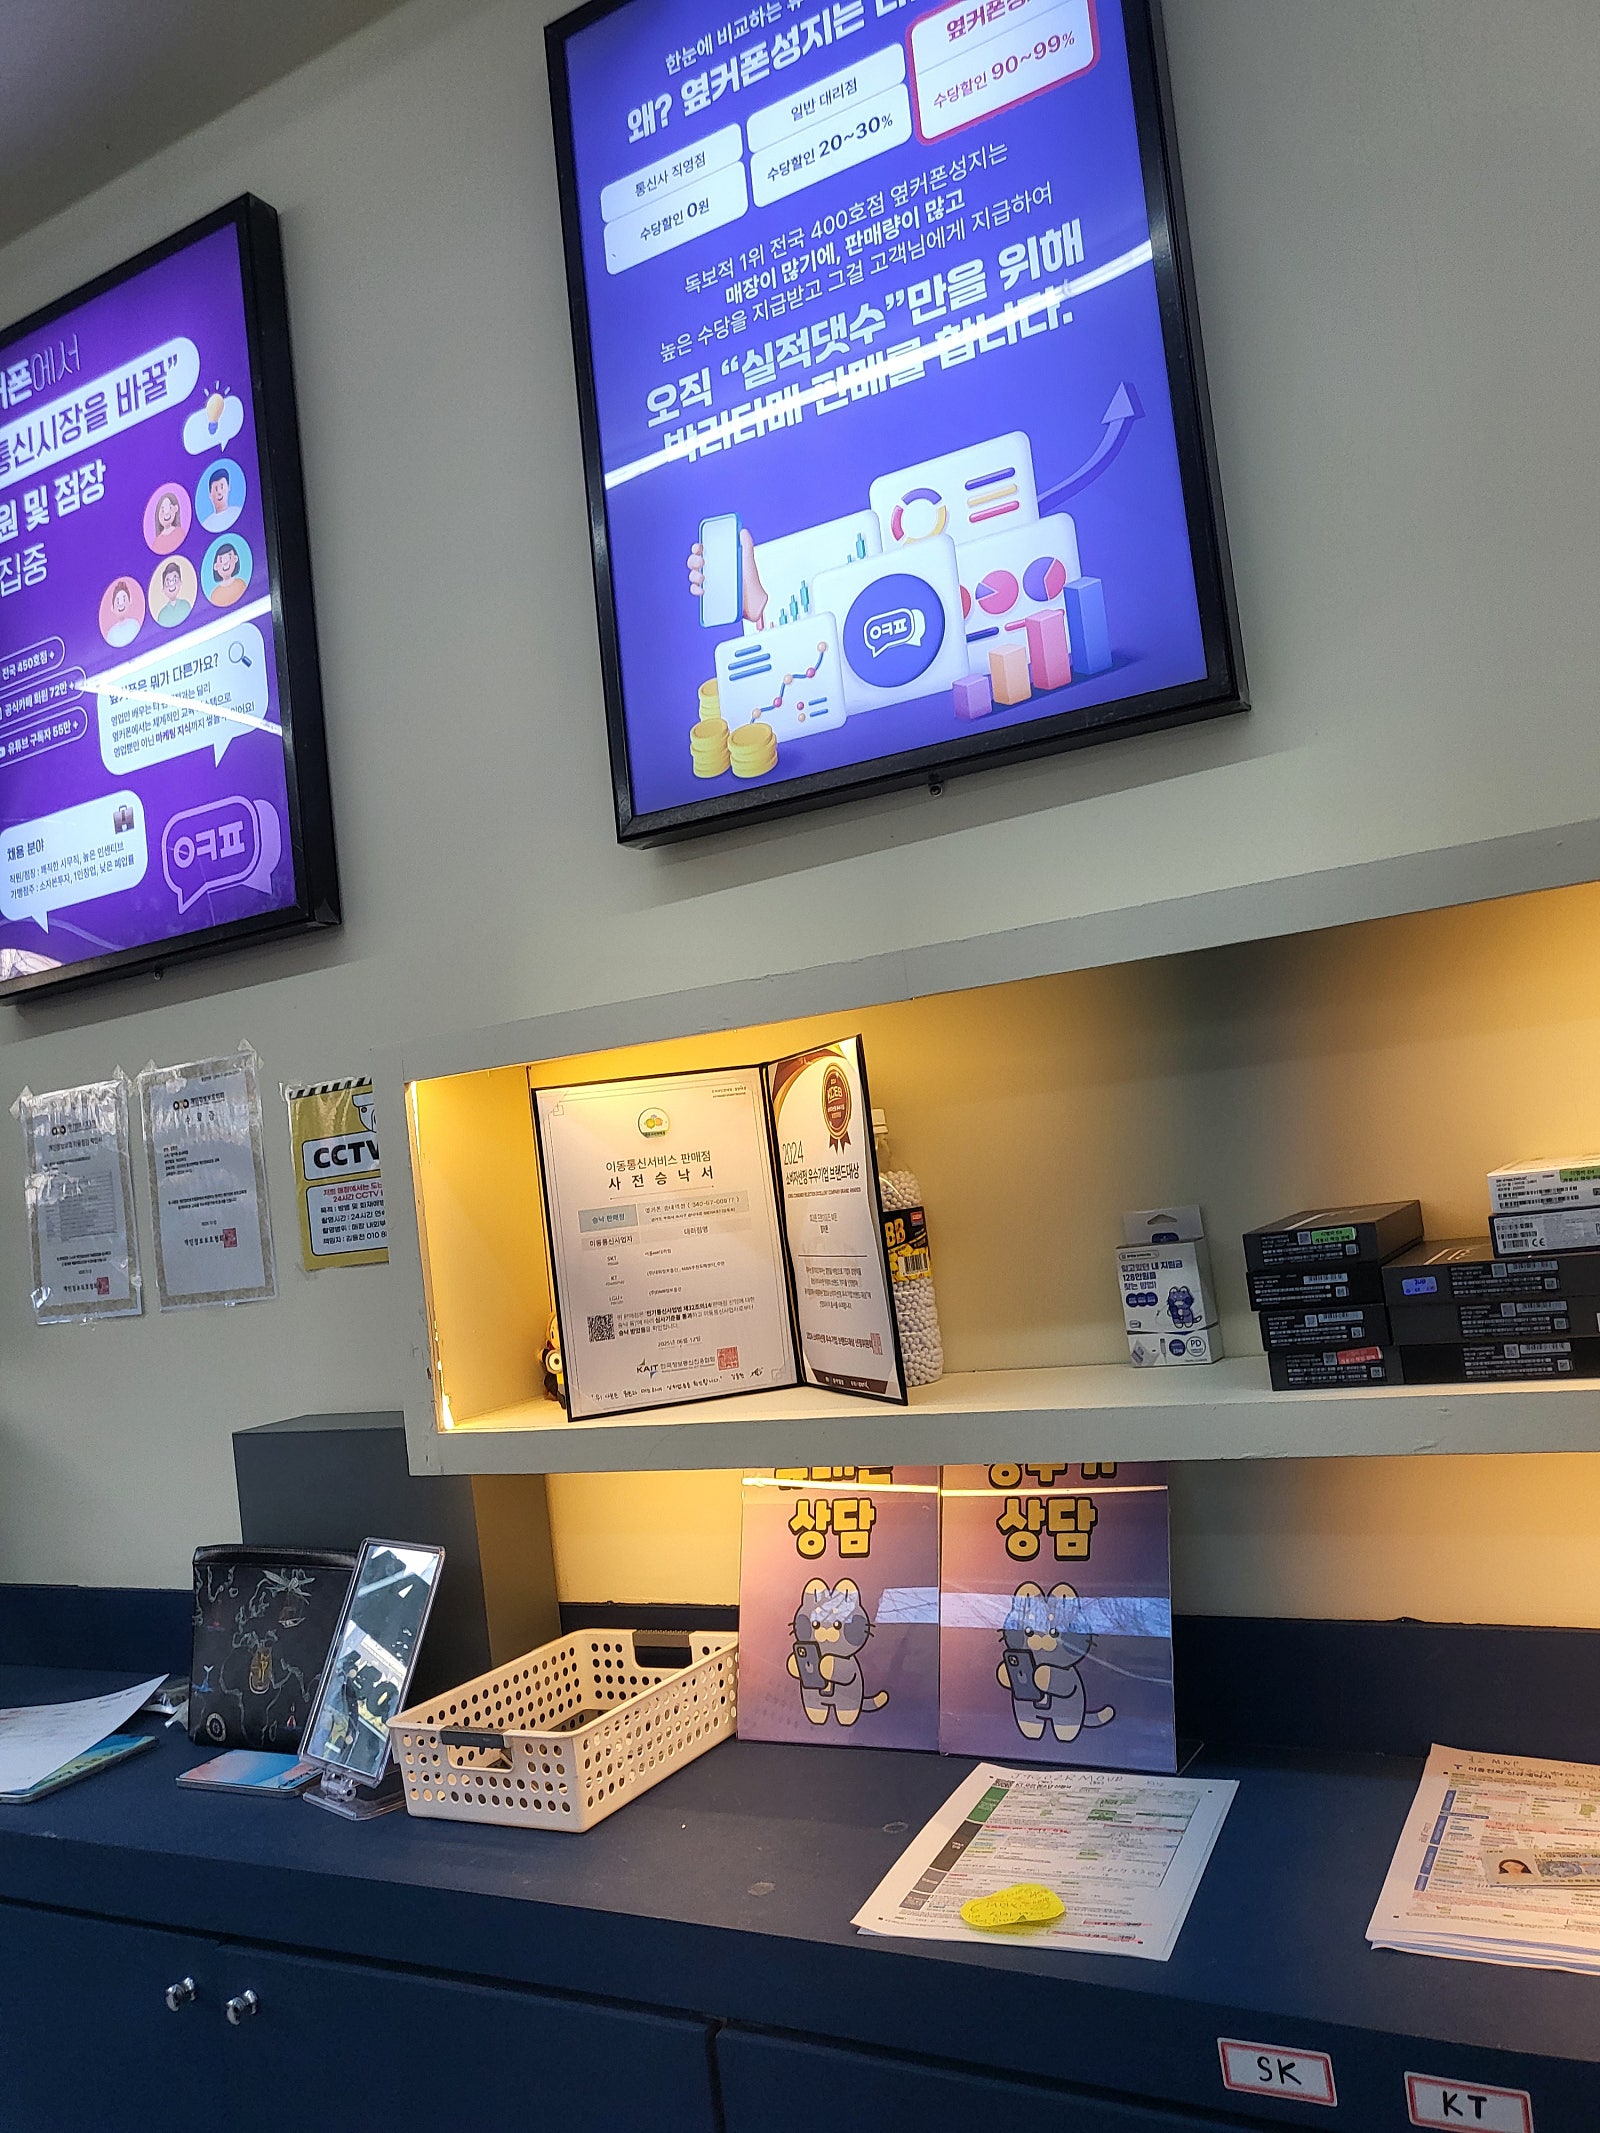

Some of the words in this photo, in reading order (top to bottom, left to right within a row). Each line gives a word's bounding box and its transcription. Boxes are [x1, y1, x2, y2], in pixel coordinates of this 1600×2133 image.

[665, 33, 713, 76] 한눈에
[717, 1, 782, 46] 비교하는
[627, 92, 673, 144] 왜?
[680, 1, 865, 117] 옆커폰성지는
[934, 71, 988, 109] 수당할인
[991, 30, 1075, 80] 90~99%
[790, 98, 816, 122] 일반
[819, 77, 858, 106] 대리점
[767, 149, 816, 182] 수당할인
[818, 114, 893, 156] 20~30%
[634, 170, 668, 197] 통신사
[672, 151, 706, 177] 직영점
[640, 211, 684, 241] 수당할인
[687, 198, 710, 220] 0원
[685, 264, 734, 294] 독보적
[740, 244, 765, 272] 1위
[770, 227, 804, 259] 전국
[810, 191, 885, 241] 400호점
[890, 143, 1009, 209] 옆커폰성지는
[725, 269, 777, 305] 매장이
[781, 244, 842, 284] 많기에,
[845, 206, 920, 253] 판매량이
[925, 189, 965, 224] 많고
[660, 334, 693, 363] 높은
[698, 310, 748, 347] 수당을
[752, 281, 823, 323] 지급받고
[828, 261, 865, 291] 그걸
[871, 222, 966, 275] 고객님에게
[971, 180, 1053, 233] 지급하여
[646, 367, 712, 428] 오직
[998, 218, 1086, 289] 위해
[24, 488, 50, 532] 및
[54, 458, 107, 517] 점장
[173, 653, 219, 682] 다른가요?
[7, 844, 24, 862] 채용
[27, 838, 45, 856] 분야
[605, 1154, 677, 1173] 이동통신서비스
[680, 1150, 712, 1166] 판매점
[783, 1141, 804, 1165] 2024
[351, 1211, 373, 1221] 24시간
[355, 1191, 379, 1200] CCTV
[367, 1231, 380, 1239] 010
[607, 1213, 625, 1223] 판매점
[589, 1234, 633, 1247] 이동통신사업자
[1190, 1339, 1202, 1348] PD
[636, 1364, 659, 1373] KAIT
[788, 1498, 876, 1560] 상담
[997, 1496, 1098, 1562] 상담
[1257, 2056, 1302, 2086] SK
[1442, 2090, 1488, 2119] KT
